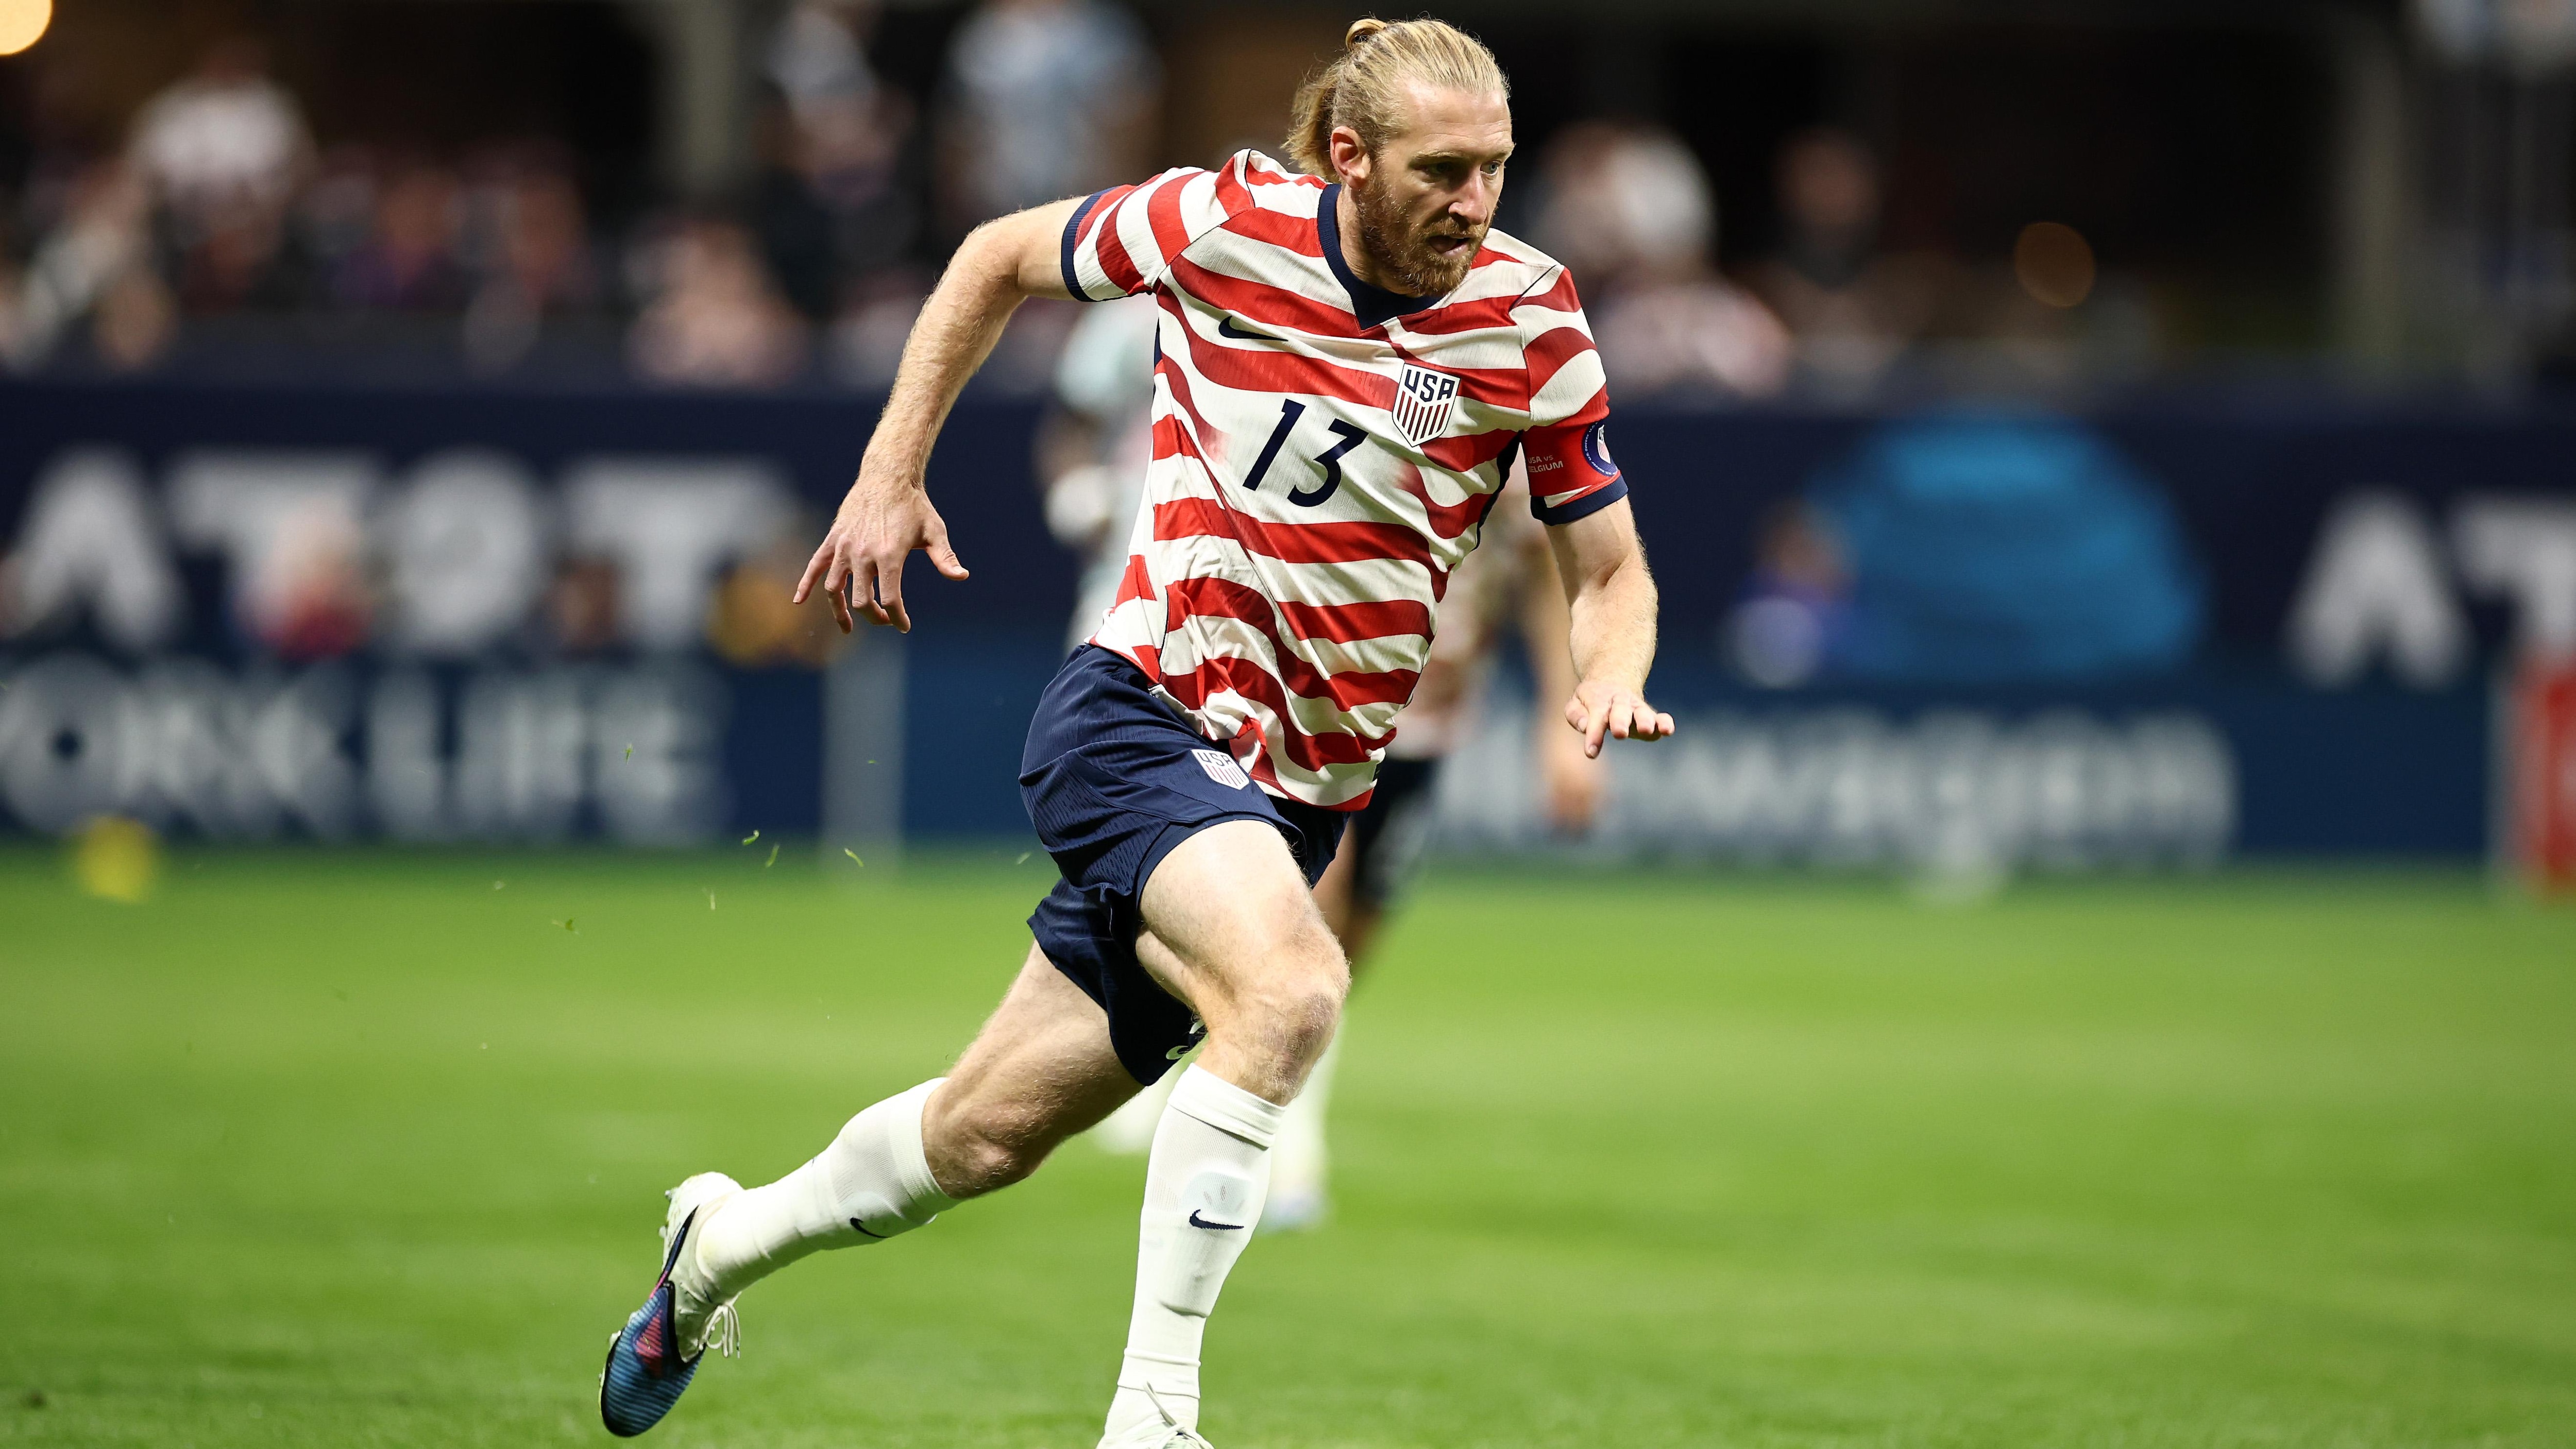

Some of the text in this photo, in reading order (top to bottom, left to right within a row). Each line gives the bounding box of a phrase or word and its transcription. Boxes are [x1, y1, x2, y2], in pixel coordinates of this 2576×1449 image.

[1404, 369, 1455, 402] USA
[1242, 399, 1368, 507] 13
[1197, 752, 1233, 766] USA
